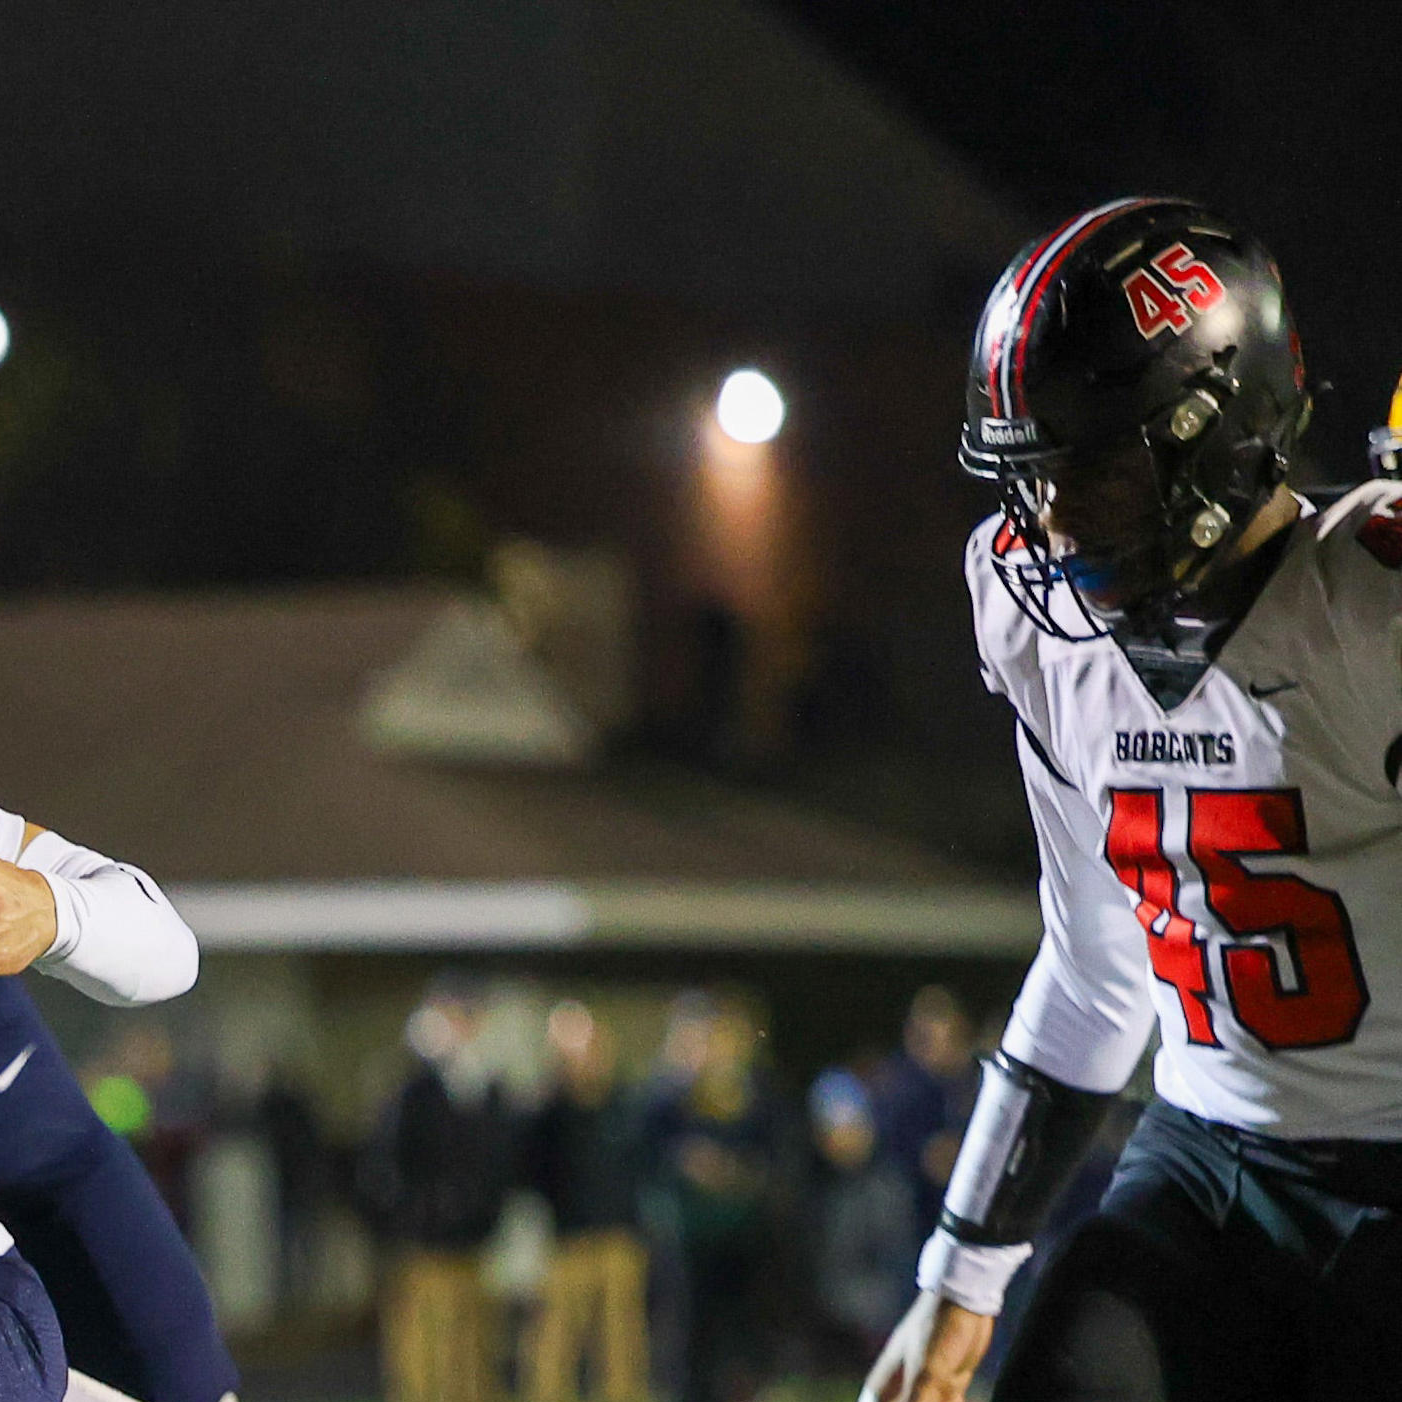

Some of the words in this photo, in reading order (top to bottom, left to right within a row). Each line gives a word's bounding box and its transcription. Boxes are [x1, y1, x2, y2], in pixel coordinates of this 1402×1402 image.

[1122, 242, 1226, 340] 45
[1115, 730, 1235, 764] BOBCATS
[1108, 787, 1371, 1048] 45
